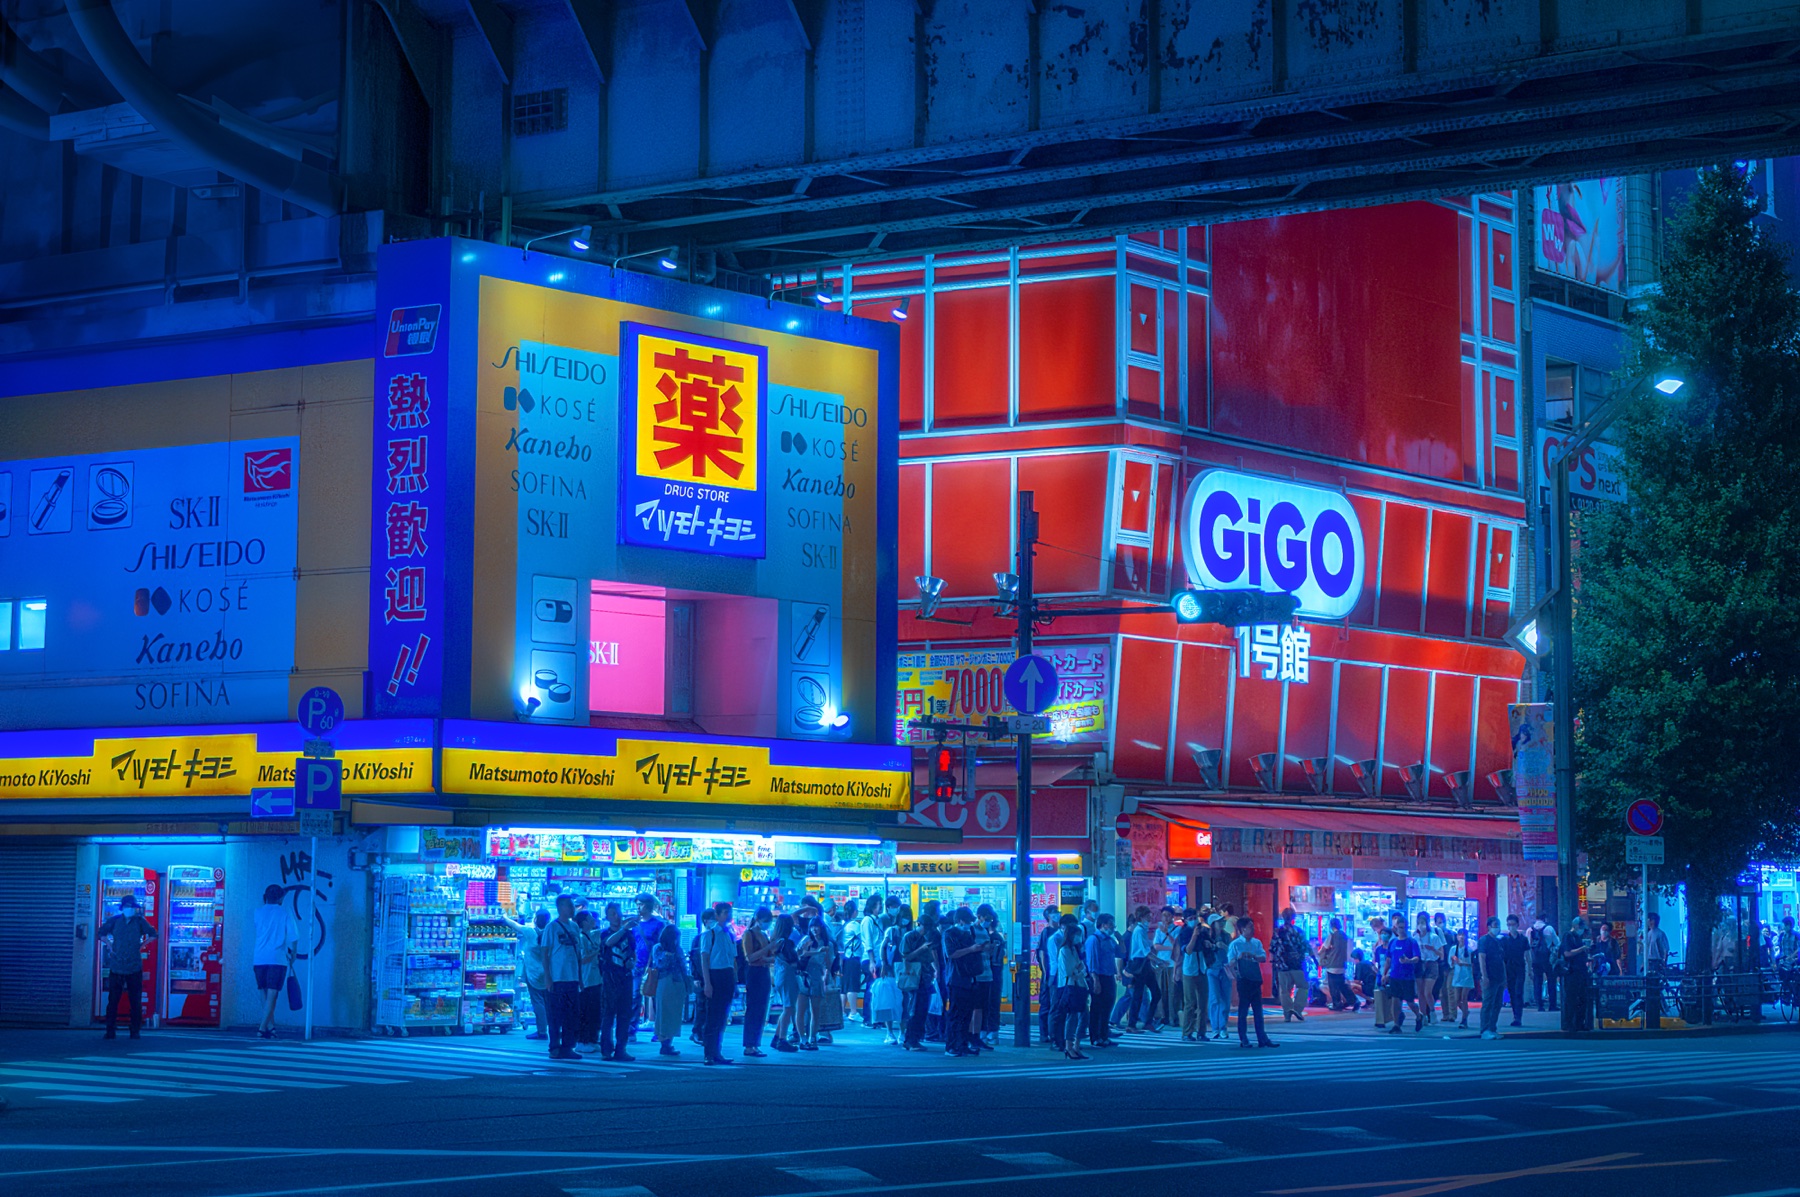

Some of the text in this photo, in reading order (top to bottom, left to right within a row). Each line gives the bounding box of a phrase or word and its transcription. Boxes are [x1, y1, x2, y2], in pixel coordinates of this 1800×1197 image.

[391, 317, 437, 342] UnionPay
[491, 346, 607, 385] SHISEIDO
[541, 393, 596, 422] KOSÉ
[653, 347, 745, 481] 薬
[770, 393, 868, 428] SHISEIDO
[504, 427, 592, 463] Kanebo
[812, 438, 859, 462] KOSÉ
[510, 469, 587, 500] SOFINA
[664, 483, 730, 503] DRUG STORE
[782, 467, 856, 499] Kanebo
[787, 507, 852, 534] SOFINA
[123, 538, 265, 573] SHISEIDO
[178, 580, 249, 613] KOSÉ
[135, 629, 243, 665] Kanebo
[1238, 624, 1311, 684] 1号館
[135, 681, 231, 711] SOFINA
[308, 697, 326, 729] P
[319, 715, 334, 730] 60
[38, 768, 92, 787] KiYoshi
[307, 763, 334, 805] P
[353, 762, 415, 781] KiYoshi
[469, 762, 616, 787] Matsumoto KiYoshi
[770, 776, 892, 799] Matsumoto KiYoshi
[898, 794, 968, 829] くじ
